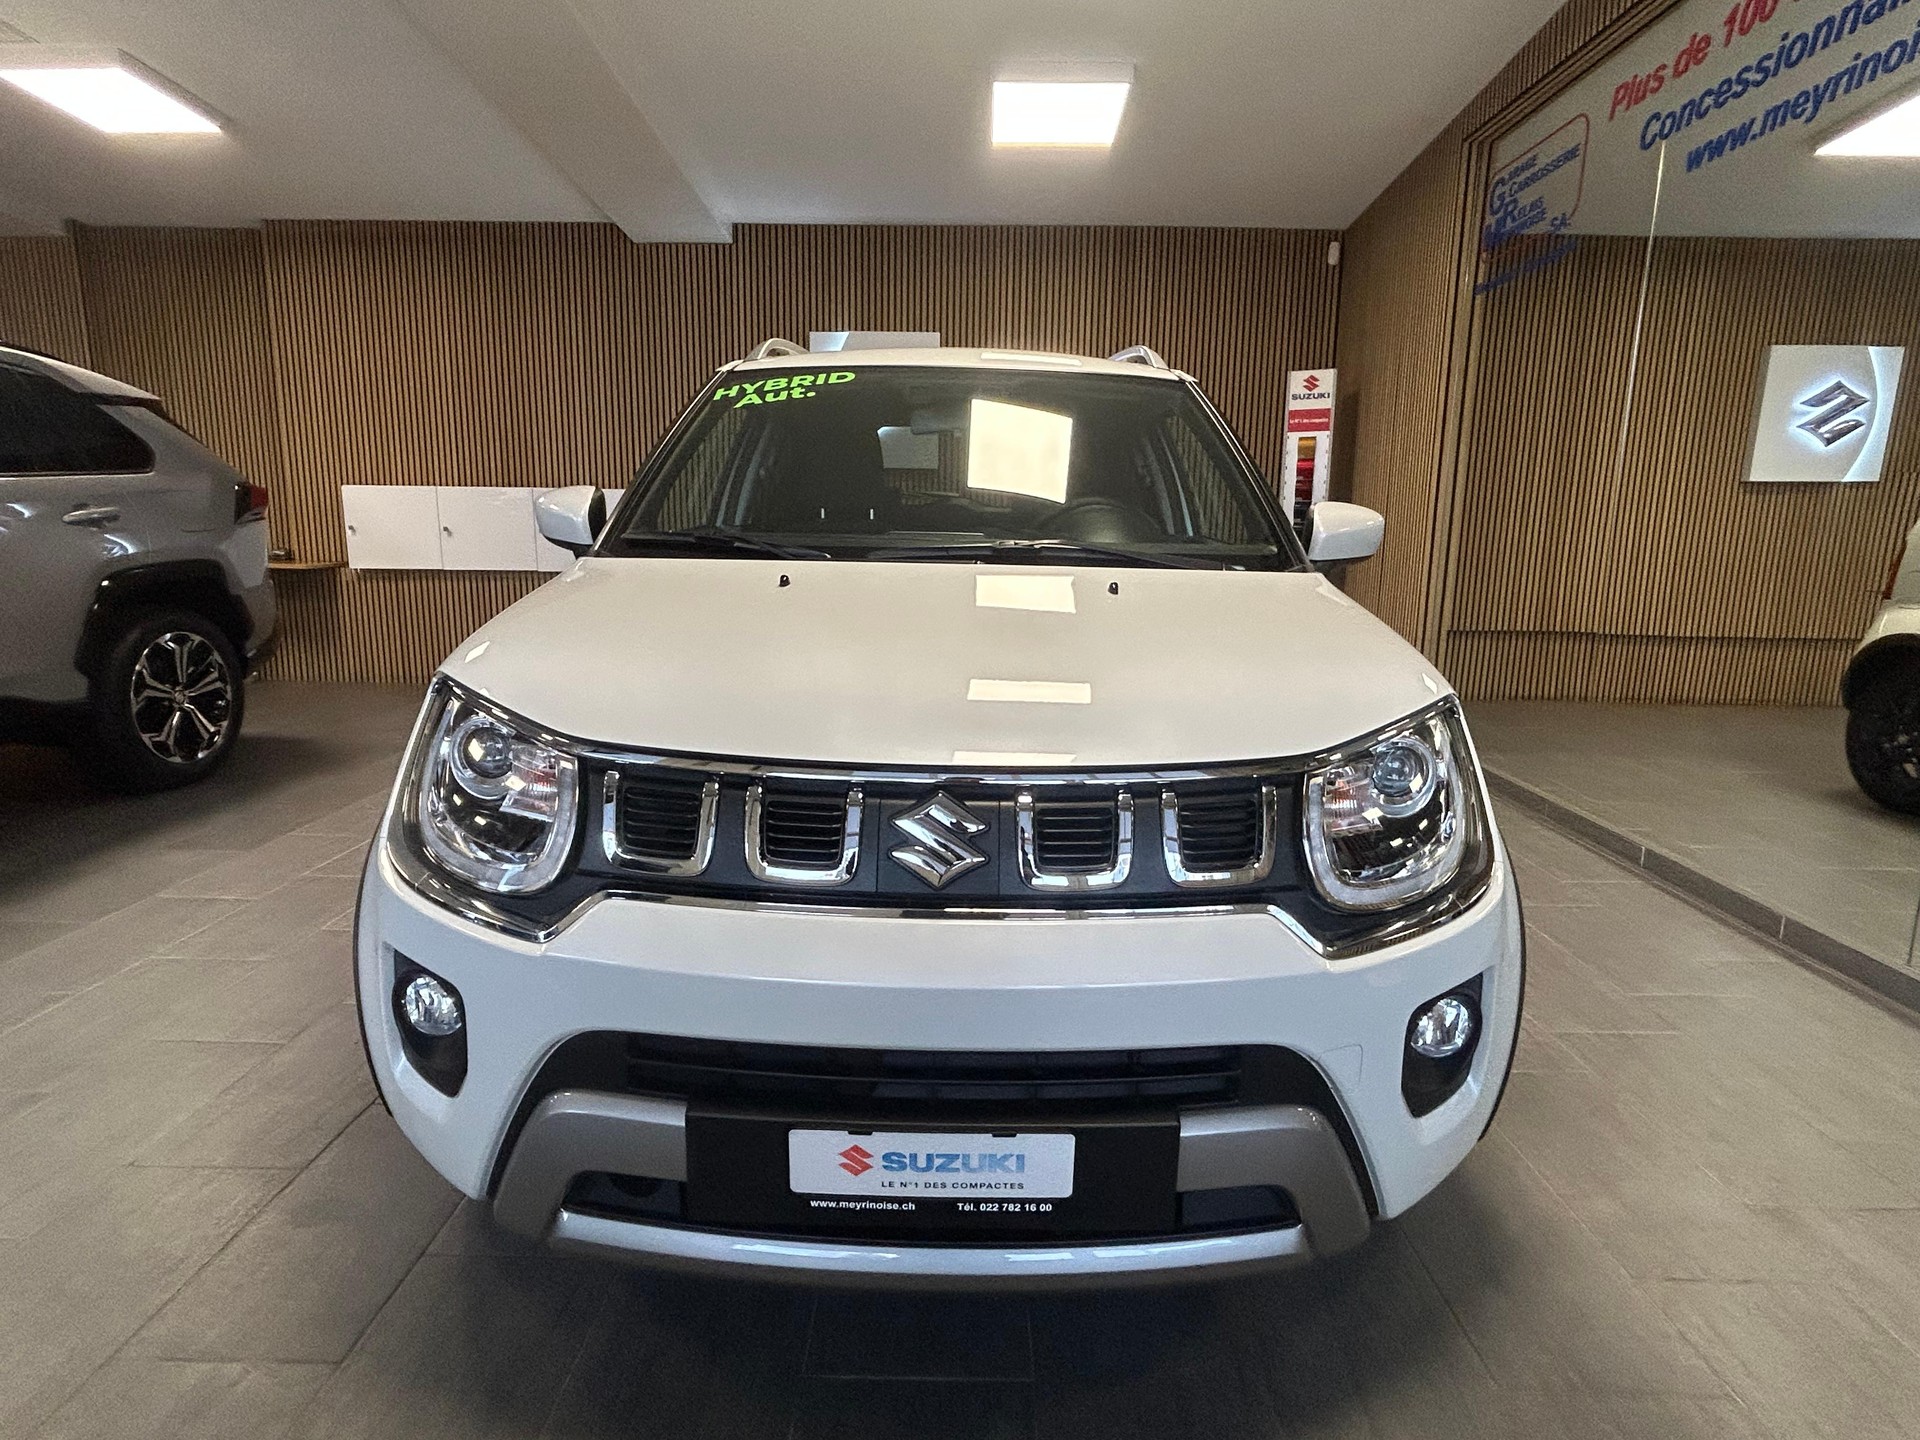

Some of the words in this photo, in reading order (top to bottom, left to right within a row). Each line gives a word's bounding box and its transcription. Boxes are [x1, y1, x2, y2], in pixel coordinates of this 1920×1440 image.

[1609, 64, 1667, 121] Plus
[1673, 32, 1712, 78] de
[1685, 19, 1920, 172] www.meyrinoi
[713, 371, 856, 400] HYBRID
[1291, 392, 1330, 400] SUZUKI
[733, 388, 816, 409] Aut.
[882, 1151, 1025, 1173] SUZUKI
[924, 1181, 947, 1189] DES
[951, 1181, 1024, 1190] COMPACTES
[810, 1200, 916, 1211] www.meyrinoise.ch
[957, 1202, 977, 1211] Tél.
[980, 1203, 999, 1211] 022
[1002, 1203, 1021, 1211] 782
[1024, 1203, 1037, 1211] 16
[1039, 1203, 1053, 1211] 00
